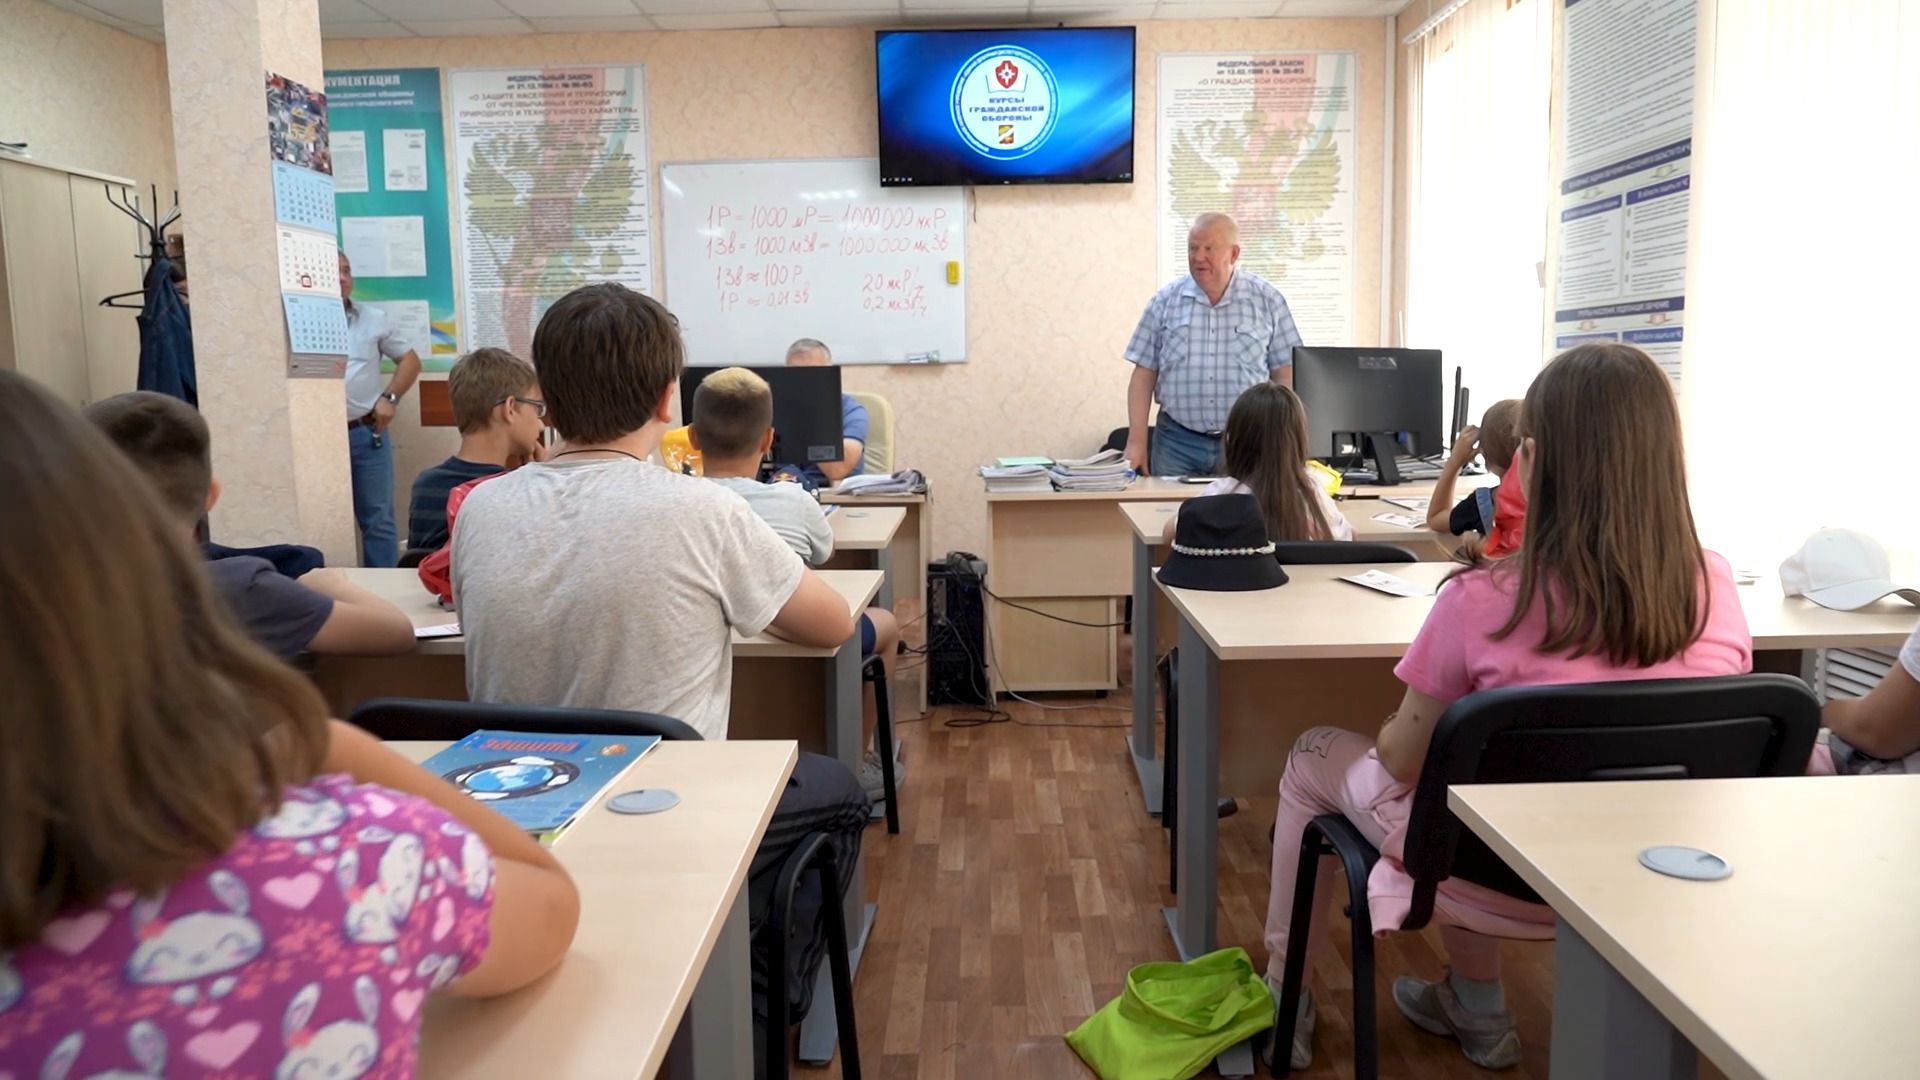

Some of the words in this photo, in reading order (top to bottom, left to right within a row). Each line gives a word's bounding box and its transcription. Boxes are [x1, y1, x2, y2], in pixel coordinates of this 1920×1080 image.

[1217, 59, 1277, 68] ФЕДЕРАЛЬНЫЙ
[1279, 59, 1305, 67] ЗАКОН
[325, 74, 400, 87] КУМЕНТАЦИЯ
[506, 73, 566, 82] ФЕДЕРАЛЬНЫЙ
[567, 73, 593, 81] ЗАКОН
[1210, 77, 1272, 86] ГРАЖДАНСКОЙ
[481, 92, 514, 101] ЗАЩИТЕ
[516, 91, 565, 100] НАСЕЛЕНИЯ
[574, 89, 627, 98] ТЕРРИТОРИЙ
[499, 99, 566, 108] ЧРЕЗВЫЧАЙНЫХ
[568, 98, 611, 107] СИТУАЦИЙ
[459, 110, 514, 118] ПРИРОДНОГО
[523, 107, 586, 117] ТЕХНОГЕННОГО
[969, 105, 1045, 114] ГРАЖДАНСКОЙ
[982, 114, 1033, 122] ОБОРОНЫ
[751, 204, 788, 230] 1000
[754, 235, 786, 257] 1000
